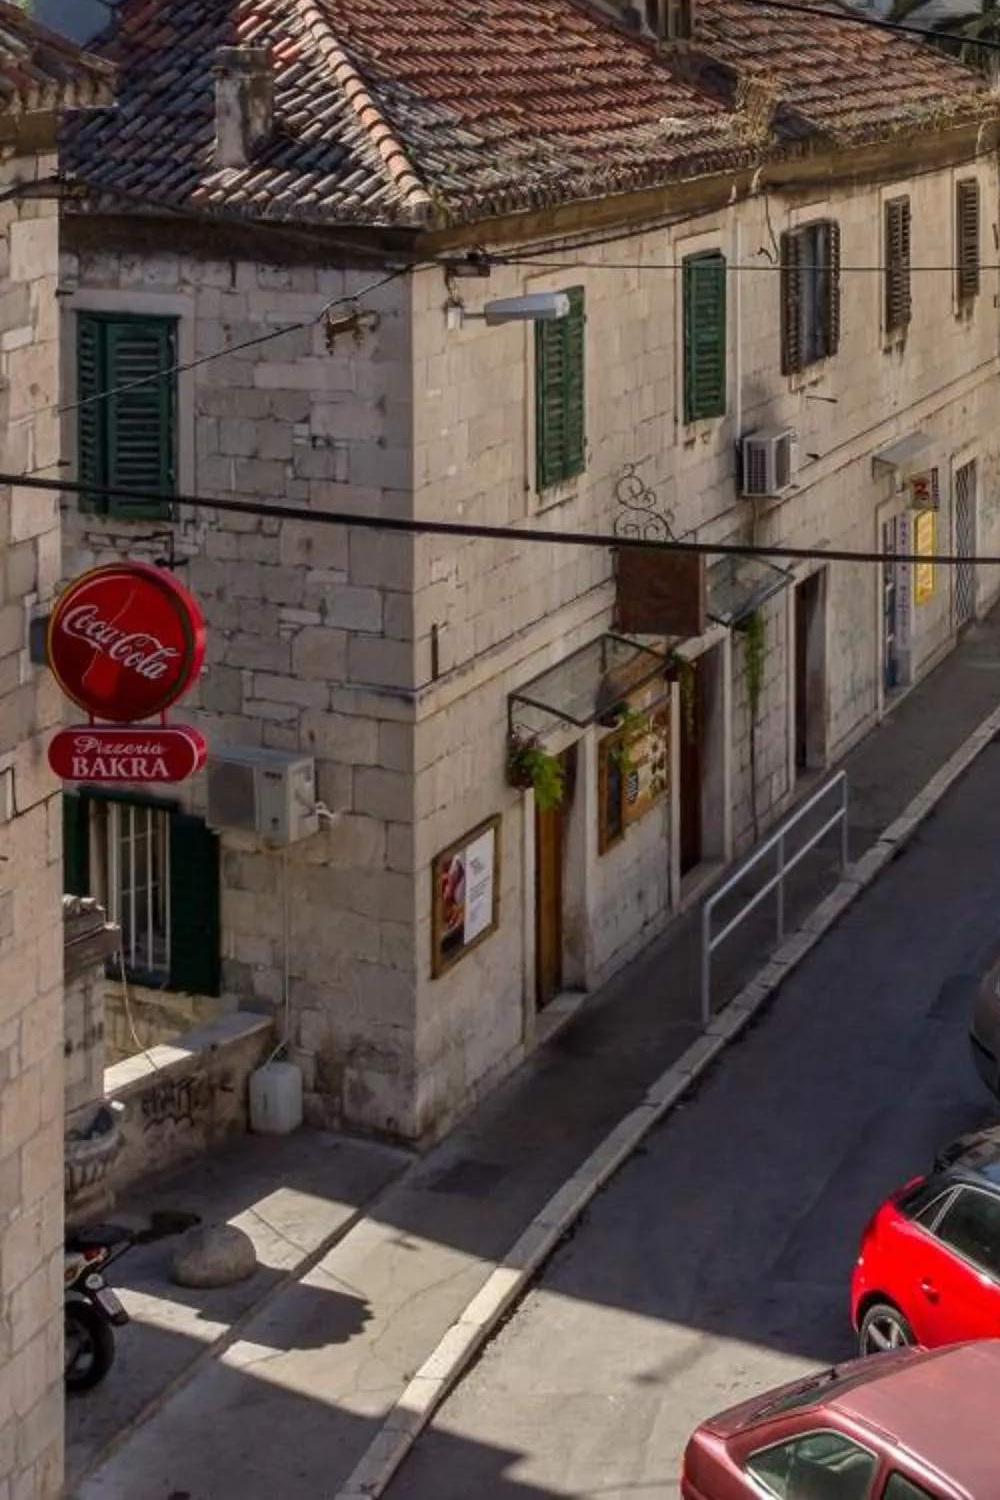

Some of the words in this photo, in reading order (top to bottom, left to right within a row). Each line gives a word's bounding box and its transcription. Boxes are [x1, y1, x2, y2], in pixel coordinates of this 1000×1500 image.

[62, 604, 179, 680] Coca-Cola
[73, 735, 162, 755] Pizzeria
[71, 757, 168, 778] BAKRA
